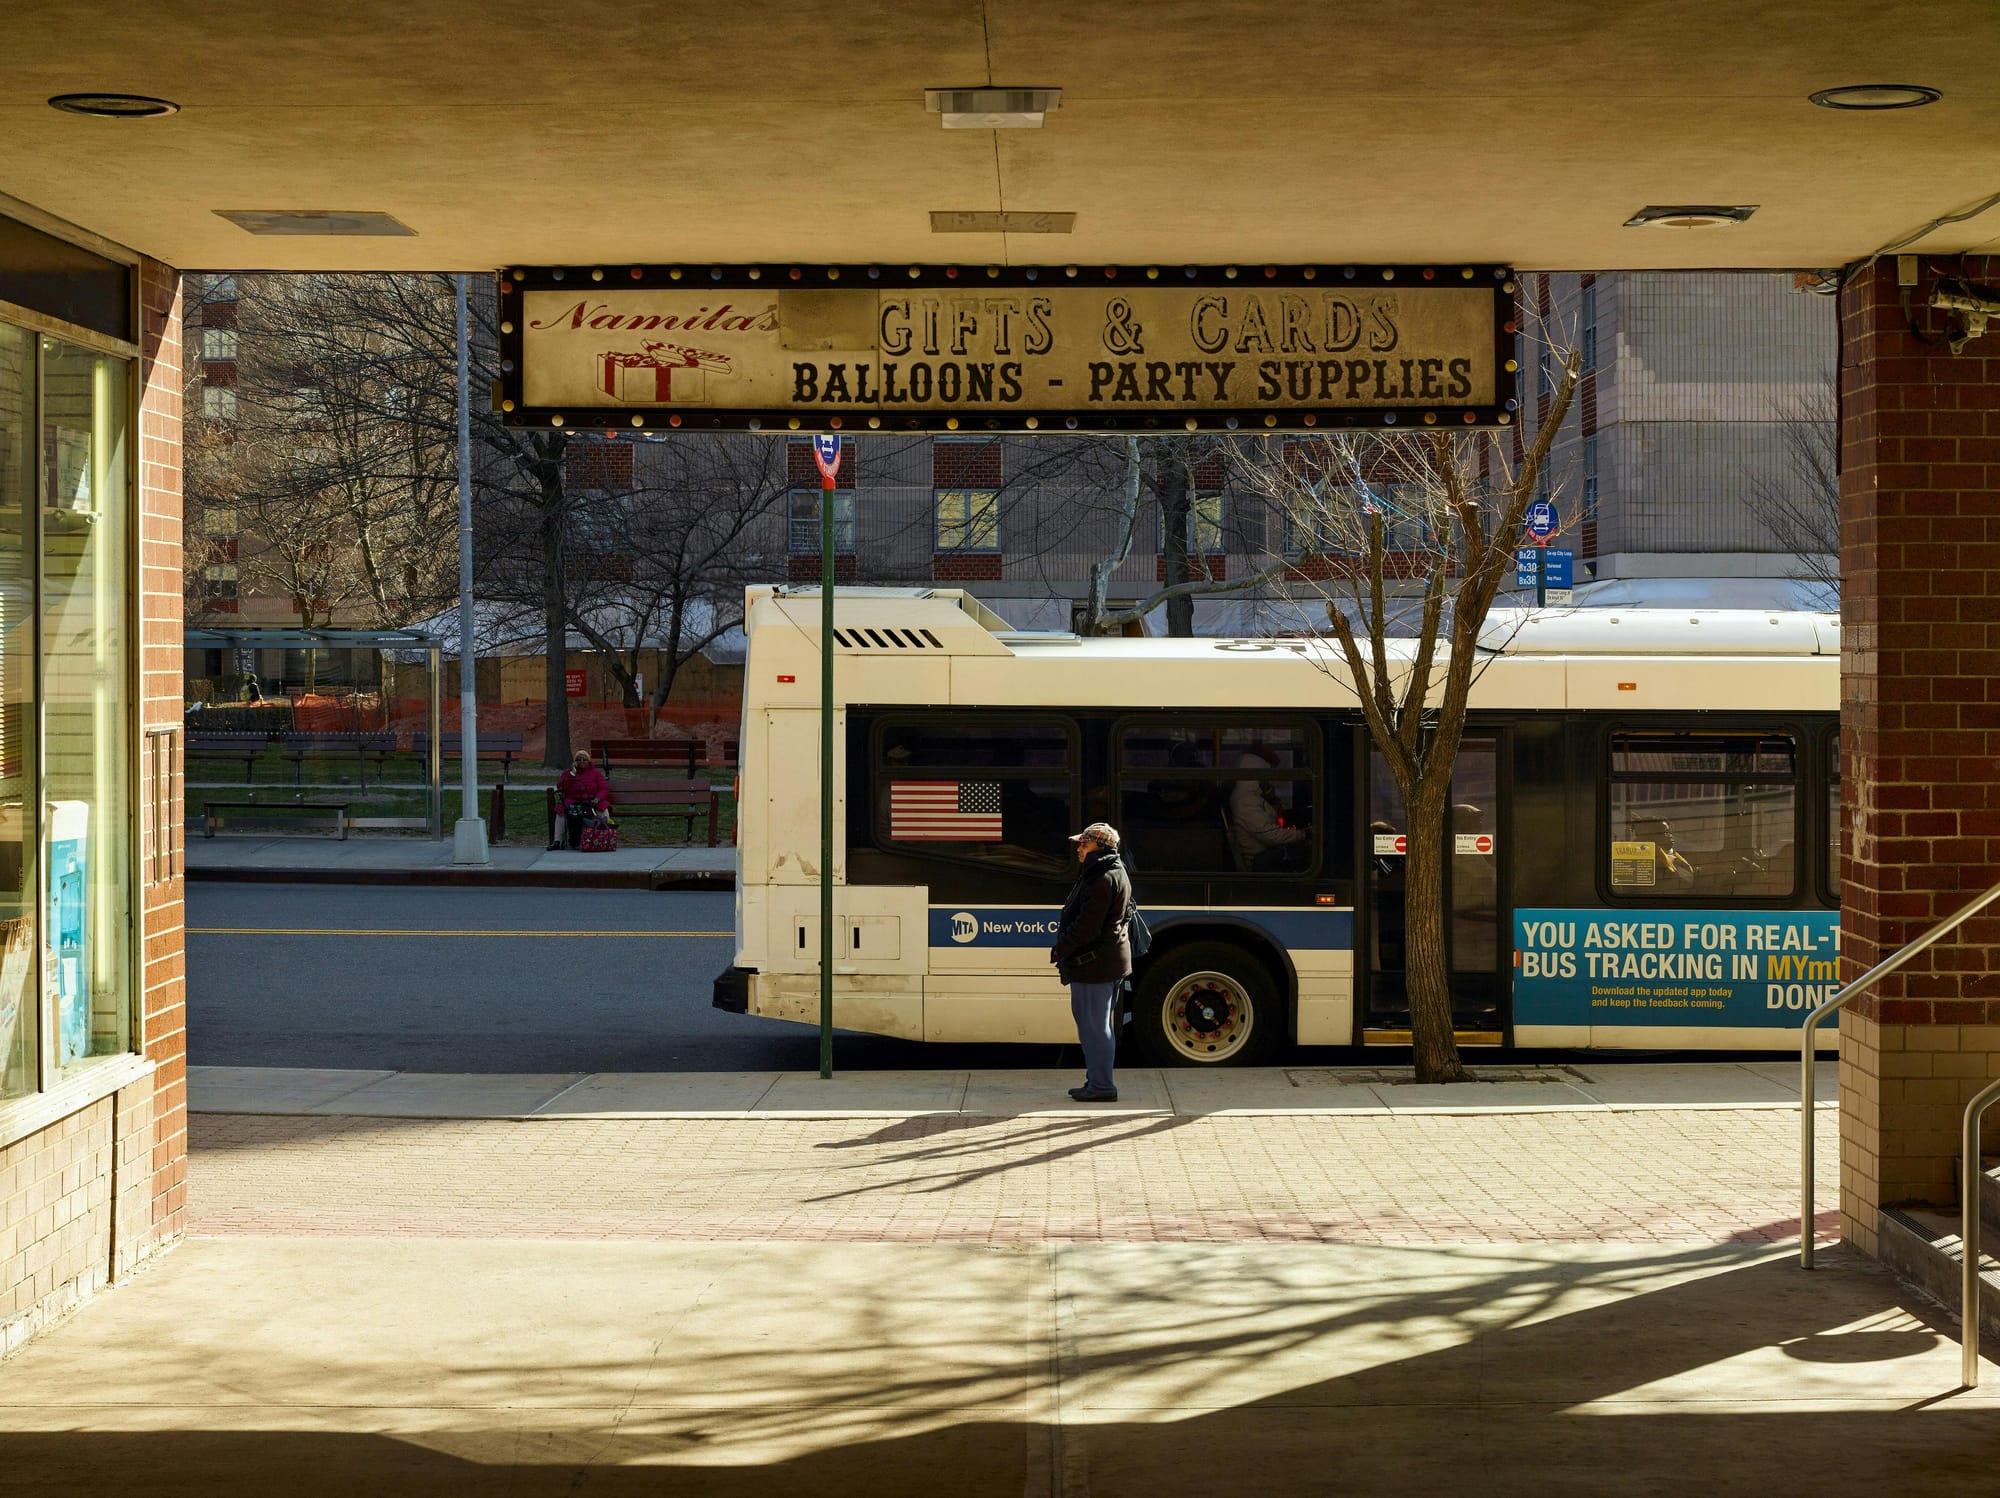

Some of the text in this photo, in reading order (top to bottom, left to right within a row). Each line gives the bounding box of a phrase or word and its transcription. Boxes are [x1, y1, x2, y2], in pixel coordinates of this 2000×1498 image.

[529, 300, 780, 333] Namita's
[877, 291, 1400, 357] GIFTS & CARDS
[792, 361, 1024, 405] BALLOONS
[1088, 361, 1236, 402] PARTY
[1258, 358, 1473, 401] SUPPLIES
[1518, 550, 1537, 560] Bx23
[951, 918, 975, 937] MTA
[983, 921, 1011, 933] New
[1015, 921, 1045, 933] York
[1522, 920, 1576, 949] YOU
[1584, 922, 1674, 950] ASKED
[1684, 923, 1737, 950] FOR
[1522, 951, 1577, 978] BUS
[1585, 952, 1723, 980] TRACKING
[1732, 954, 1758, 980] IN
[1591, 986, 1733, 999] Download the updated app today
[1591, 998, 1725, 1010] and keep the feedback coming.
